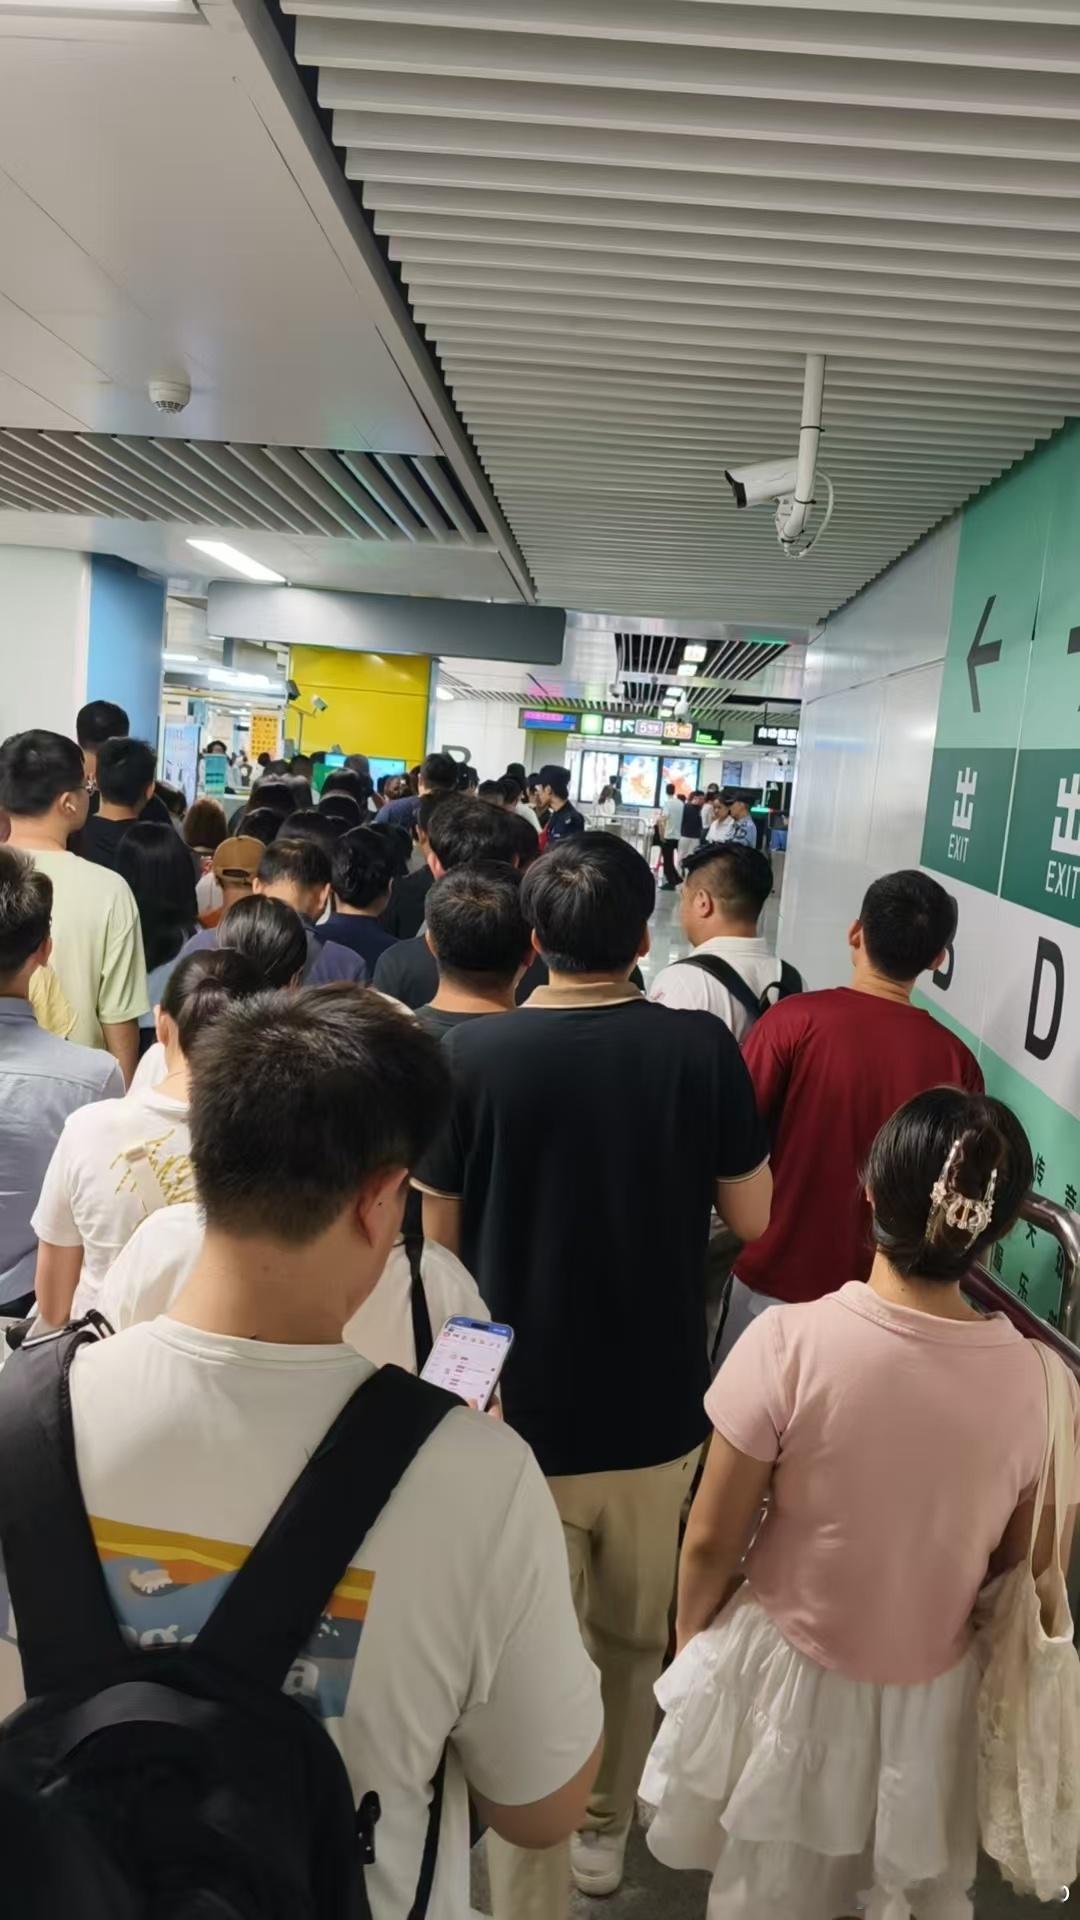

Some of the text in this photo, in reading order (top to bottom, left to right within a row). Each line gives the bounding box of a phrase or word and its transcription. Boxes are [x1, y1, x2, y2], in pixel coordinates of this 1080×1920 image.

[952, 767, 978, 830] 出
[947, 833, 970, 863] EXIT
[1045, 860, 1080, 900] EXIT
[1024, 935, 1065, 1061] D
